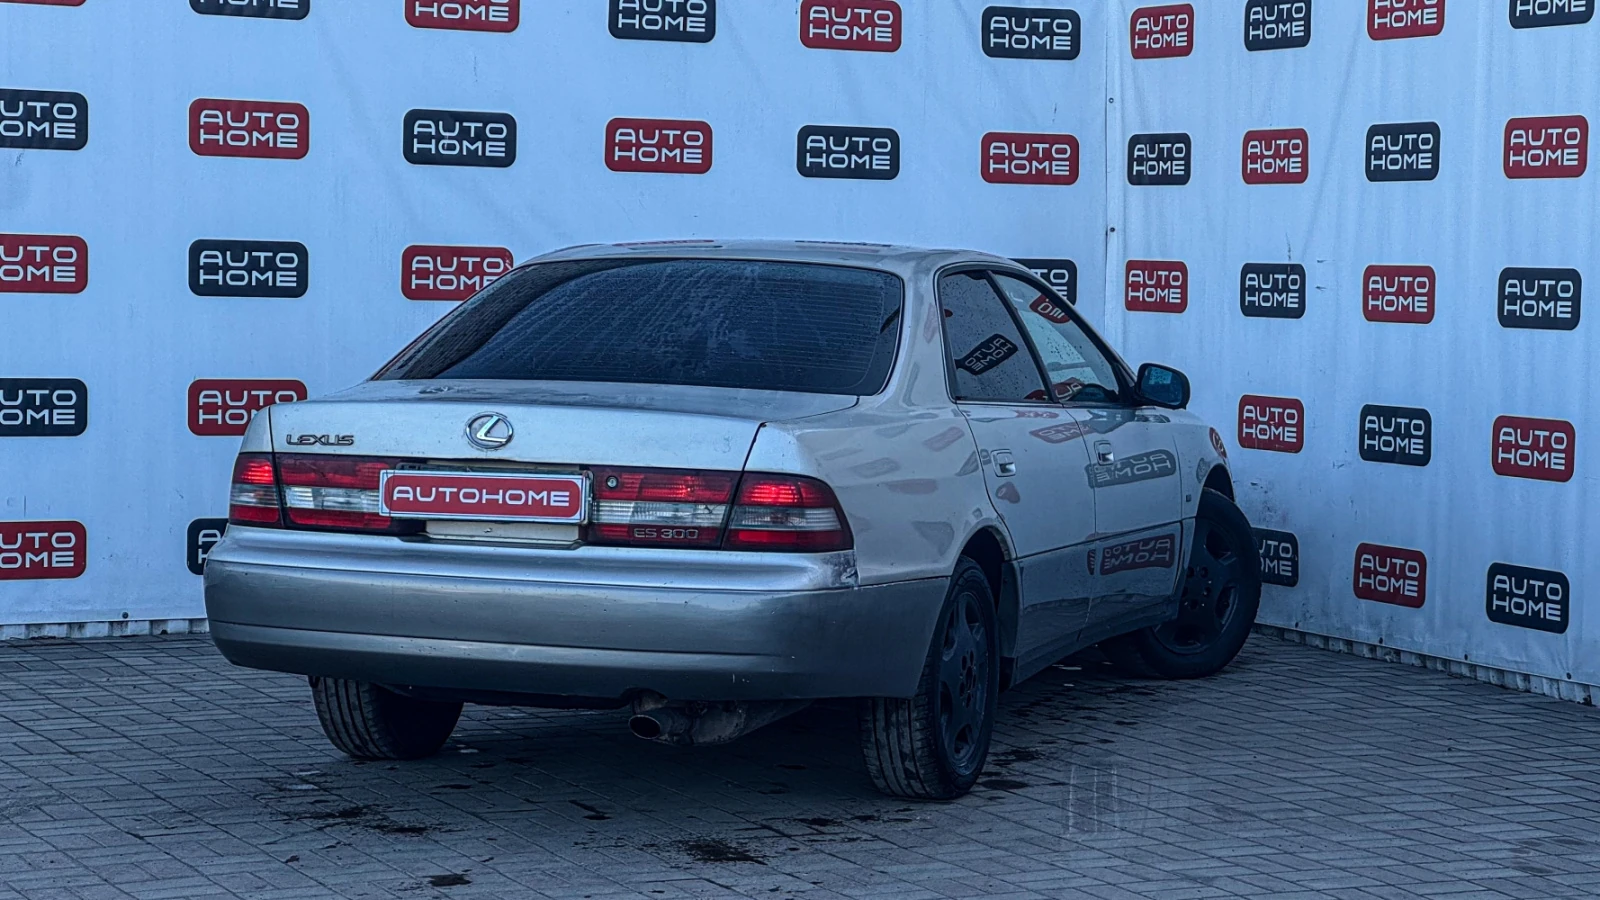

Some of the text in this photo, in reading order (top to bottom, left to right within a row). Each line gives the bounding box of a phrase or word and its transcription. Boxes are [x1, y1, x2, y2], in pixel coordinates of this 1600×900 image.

[415, 1, 509, 22] HOME
[618, 0, 707, 14] AUTO
[809, 5, 893, 24] AUTO
[1249, 2, 1306, 23] AUTO
[1516, 0, 1587, 16] HOME
[618, 13, 706, 32] HOME
[990, 16, 1072, 33] AUTO
[1135, 13, 1188, 31] AUTO
[1374, 7, 1438, 29] HOME
[809, 23, 893, 41] HOME
[1249, 20, 1305, 40] HOME
[990, 33, 1072, 50] HOME
[1134, 31, 1188, 49] HOME
[0, 100, 77, 119] UTO
[200, 109, 299, 129] AUTO
[0, 120, 76, 139] OME
[199, 128, 298, 148] HOME
[413, 119, 507, 139] AUTO
[615, 128, 704, 145] AUTO
[1510, 127, 1580, 147] AUTO
[413, 138, 506, 157] HOME
[806, 135, 892, 152] AUTO
[989, 142, 1071, 158] AUTO
[1133, 143, 1186, 159] AUTO
[1247, 139, 1302, 156] AUTO
[1371, 133, 1433, 151] AUTO
[614, 146, 703, 163] HOME
[806, 153, 891, 170] HOME
[1371, 153, 1433, 171] HOME
[1509, 148, 1579, 167] HOME
[989, 159, 1070, 175] HOME
[1132, 160, 1185, 176] HOME
[1247, 157, 1302, 173] HOME
[0, 245, 77, 263] UTO
[199, 250, 298, 268] AUTO
[0, 264, 76, 282] OME
[411, 255, 504, 273] AUTO
[199, 269, 297, 287] HOME
[1029, 268, 1068, 283] TO
[1129, 269, 1183, 286] AUTO
[1245, 273, 1300, 290] AUTO
[1368, 275, 1429, 293] AUTO
[1128, 286, 1182, 303] HOME
[1504, 279, 1574, 297] AUTO
[1245, 291, 1299, 308] HOME
[1368, 294, 1428, 313] HOME
[1503, 299, 1573, 318] HOME
[0, 389, 77, 405] UTO
[199, 390, 298, 406] AUTO
[0, 409, 76, 425] OME
[199, 409, 258, 425] HO
[1243, 405, 1298, 424] AUTO
[1242, 422, 1297, 443] HOME
[1365, 415, 1425, 436] AUTO
[286, 433, 355, 447] LEXUS
[1364, 434, 1424, 455] HOME
[1499, 427, 1567, 450] AUTO
[1498, 446, 1566, 470] HOME
[392, 484, 571, 508] AUTOHOME
[0, 532, 76, 549] UTO
[633, 527, 699, 539] ES 300
[1259, 540, 1293, 558] TO
[0, 551, 75, 568] OME
[1260, 556, 1292, 576] ME
[1360, 553, 1420, 577] AUTO
[1359, 572, 1419, 597] HOME
[1493, 574, 1562, 601] AUTO
[1492, 594, 1561, 622] HOME
